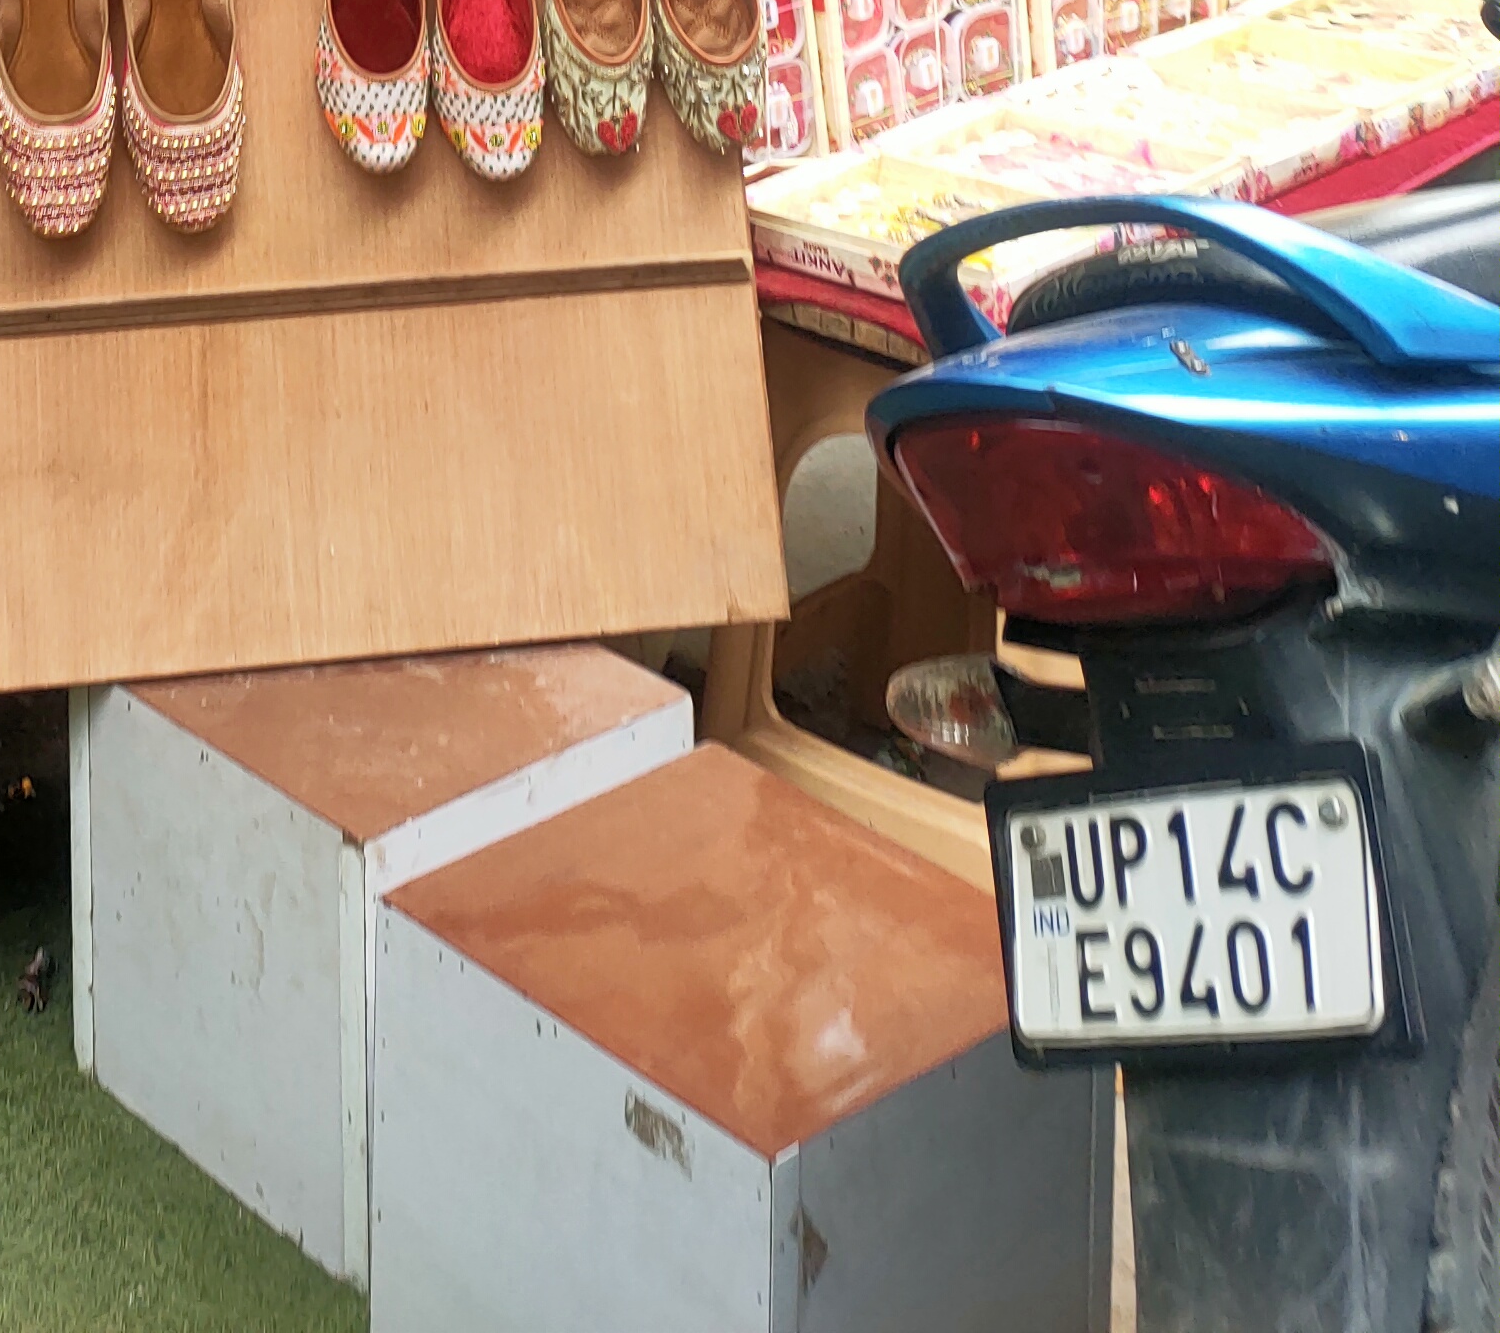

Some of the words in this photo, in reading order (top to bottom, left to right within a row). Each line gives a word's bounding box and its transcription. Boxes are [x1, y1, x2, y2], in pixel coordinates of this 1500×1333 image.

[1065, 801, 1315, 911] UP14C
[1033, 905, 1070, 938] IND
[1075, 914, 1319, 1023] E9401
